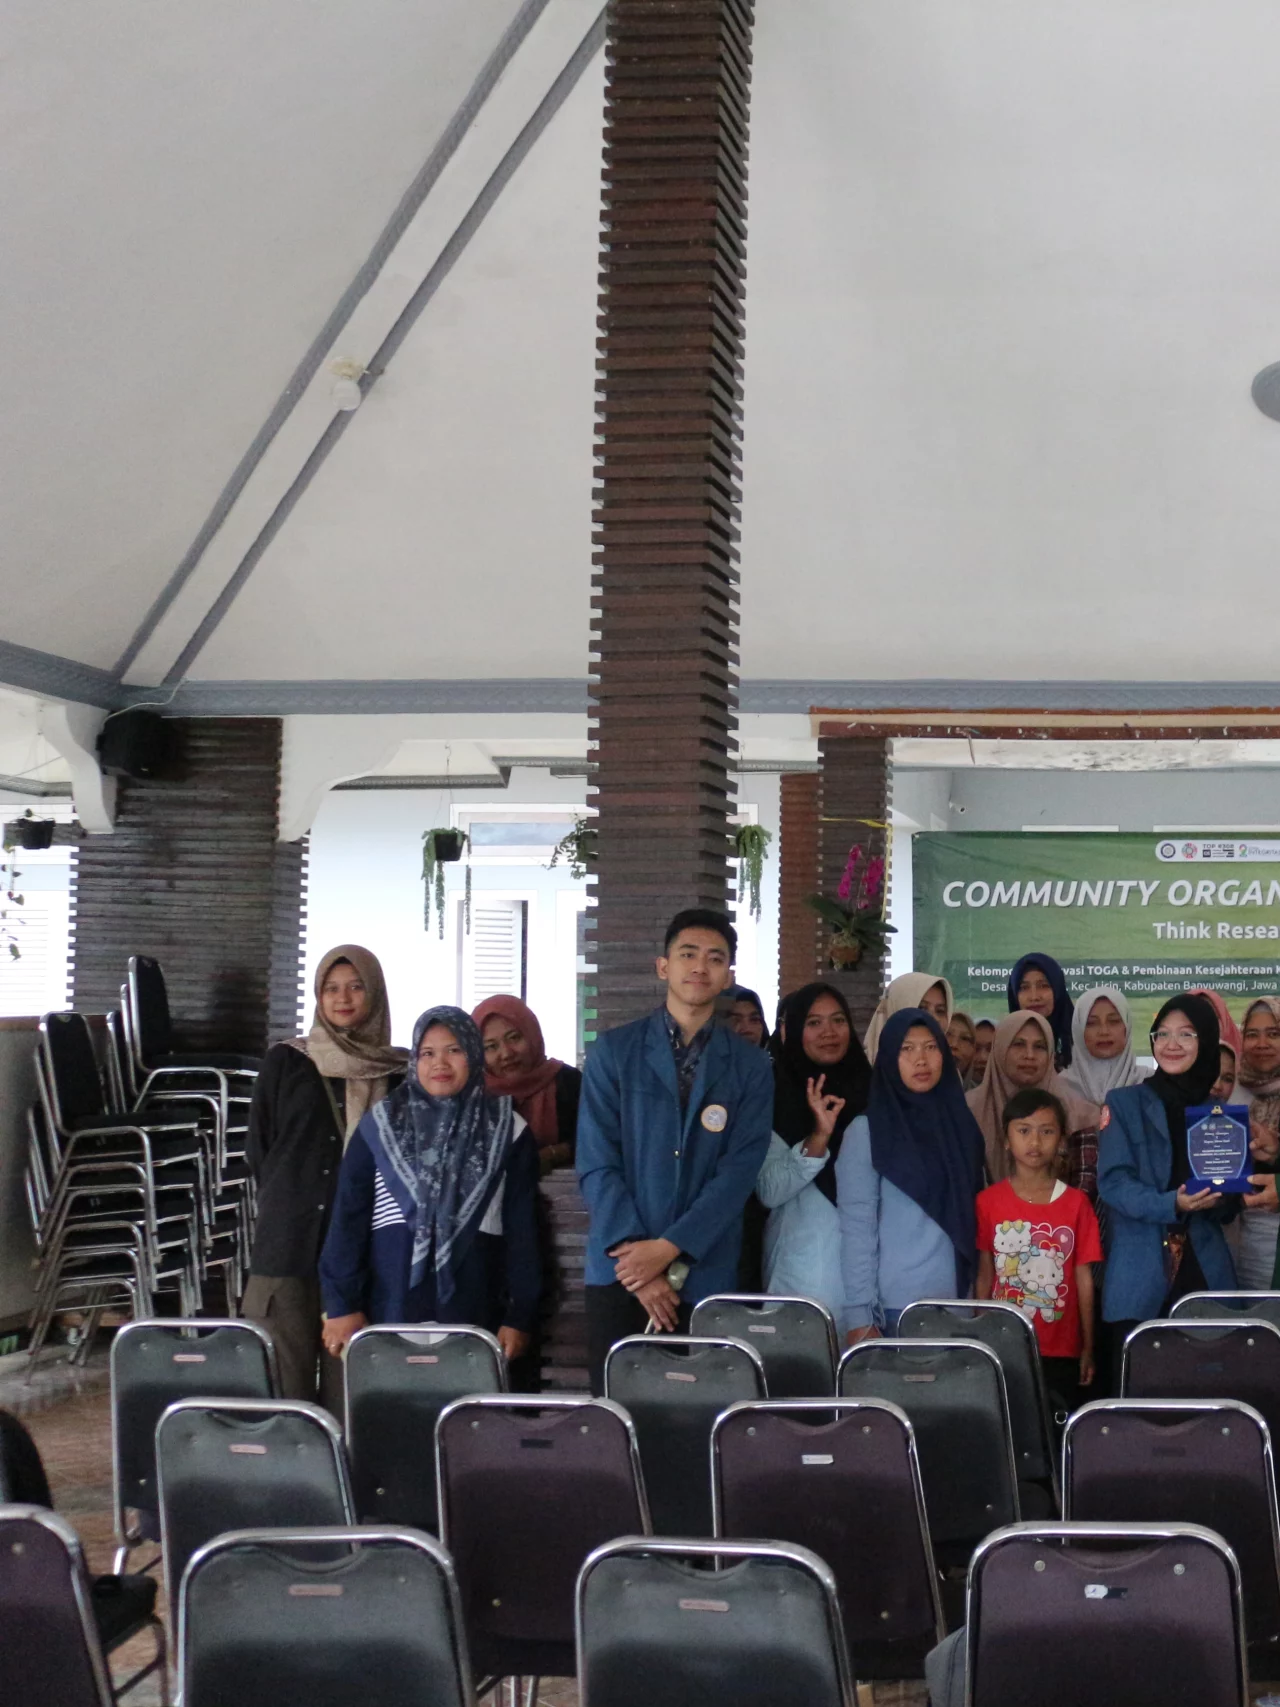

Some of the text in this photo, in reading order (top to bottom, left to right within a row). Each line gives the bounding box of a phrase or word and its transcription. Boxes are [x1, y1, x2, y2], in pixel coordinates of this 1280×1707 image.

[942, 880, 1160, 908] COMMUNITY
[1152, 921, 1211, 940] Think
[1087, 965, 1119, 976] TOGA
[1121, 965, 1130, 975] &
[1132, 965, 1193, 976] Pembinaan
[1195, 964, 1273, 977] Kesejahteraan
[981, 982, 1008, 992] Desa
[1124, 981, 1181, 992] Kabupaten
[1251, 980, 1278, 990] Jawa
